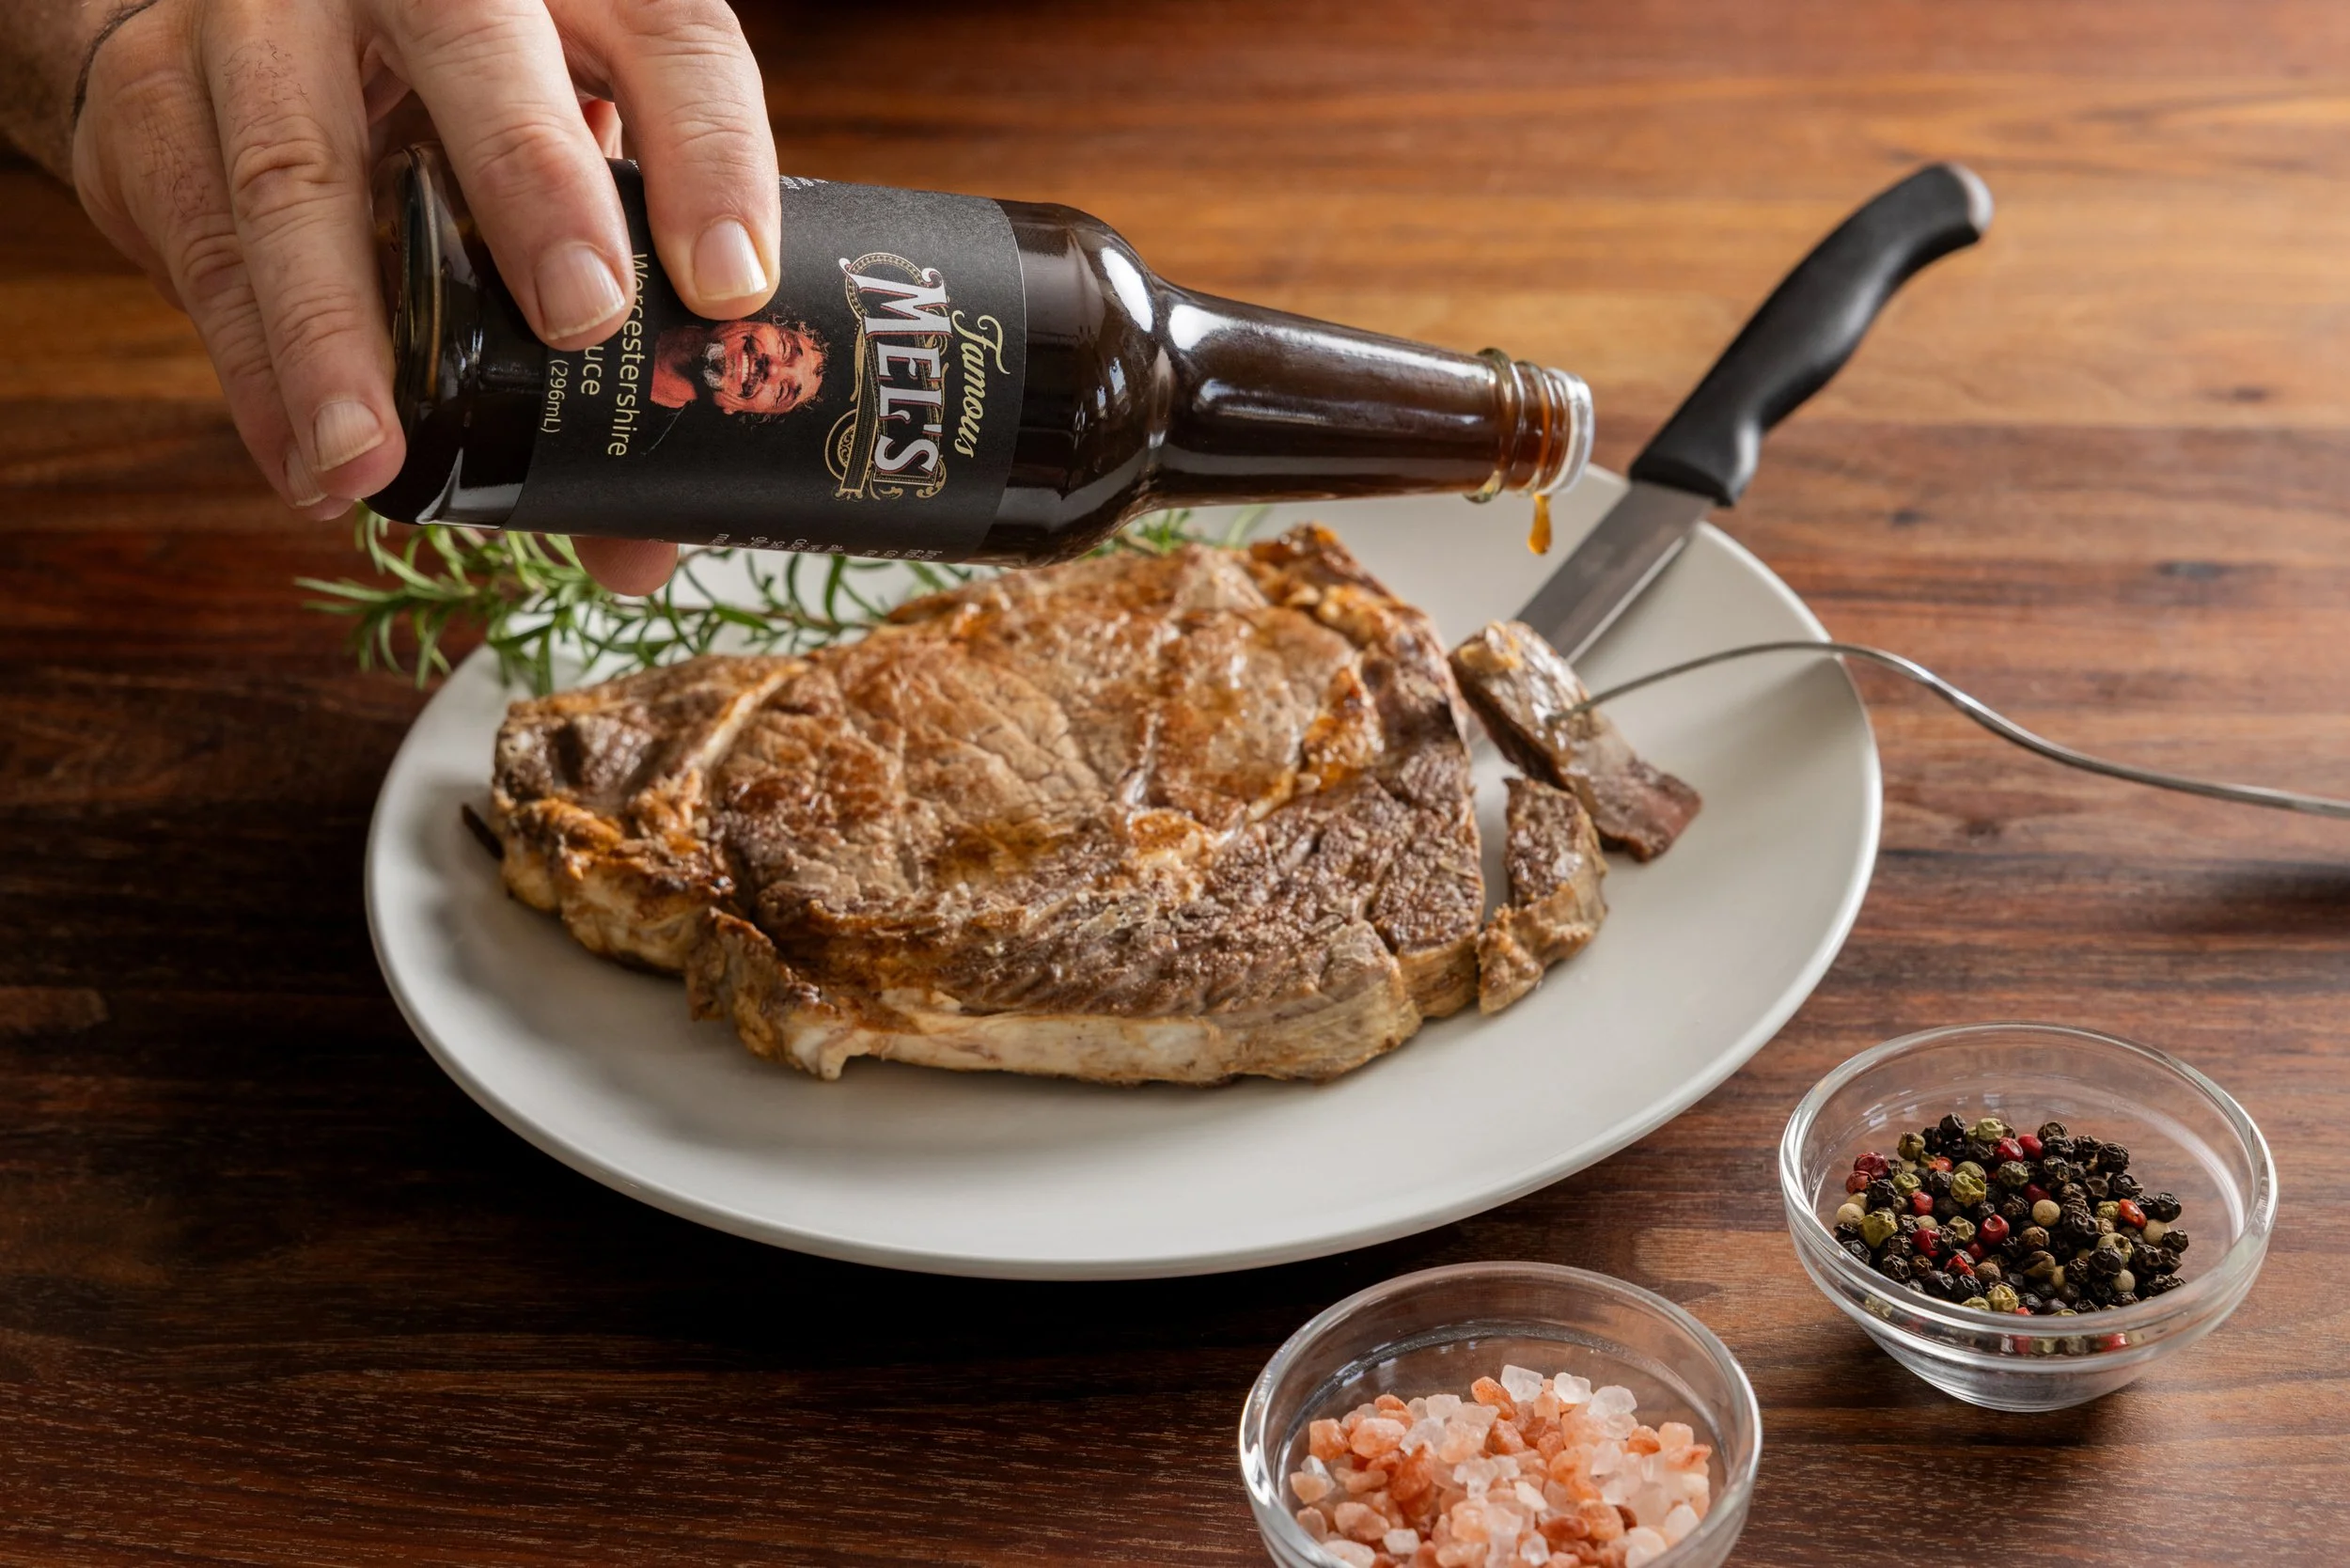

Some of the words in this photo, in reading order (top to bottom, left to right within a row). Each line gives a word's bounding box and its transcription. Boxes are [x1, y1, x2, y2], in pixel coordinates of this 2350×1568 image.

[540, 359, 570, 434] (296mL)
[581, 345, 604, 396] uce
[838, 258, 952, 476] MEL'S
[951, 309, 1010, 459] Famous
